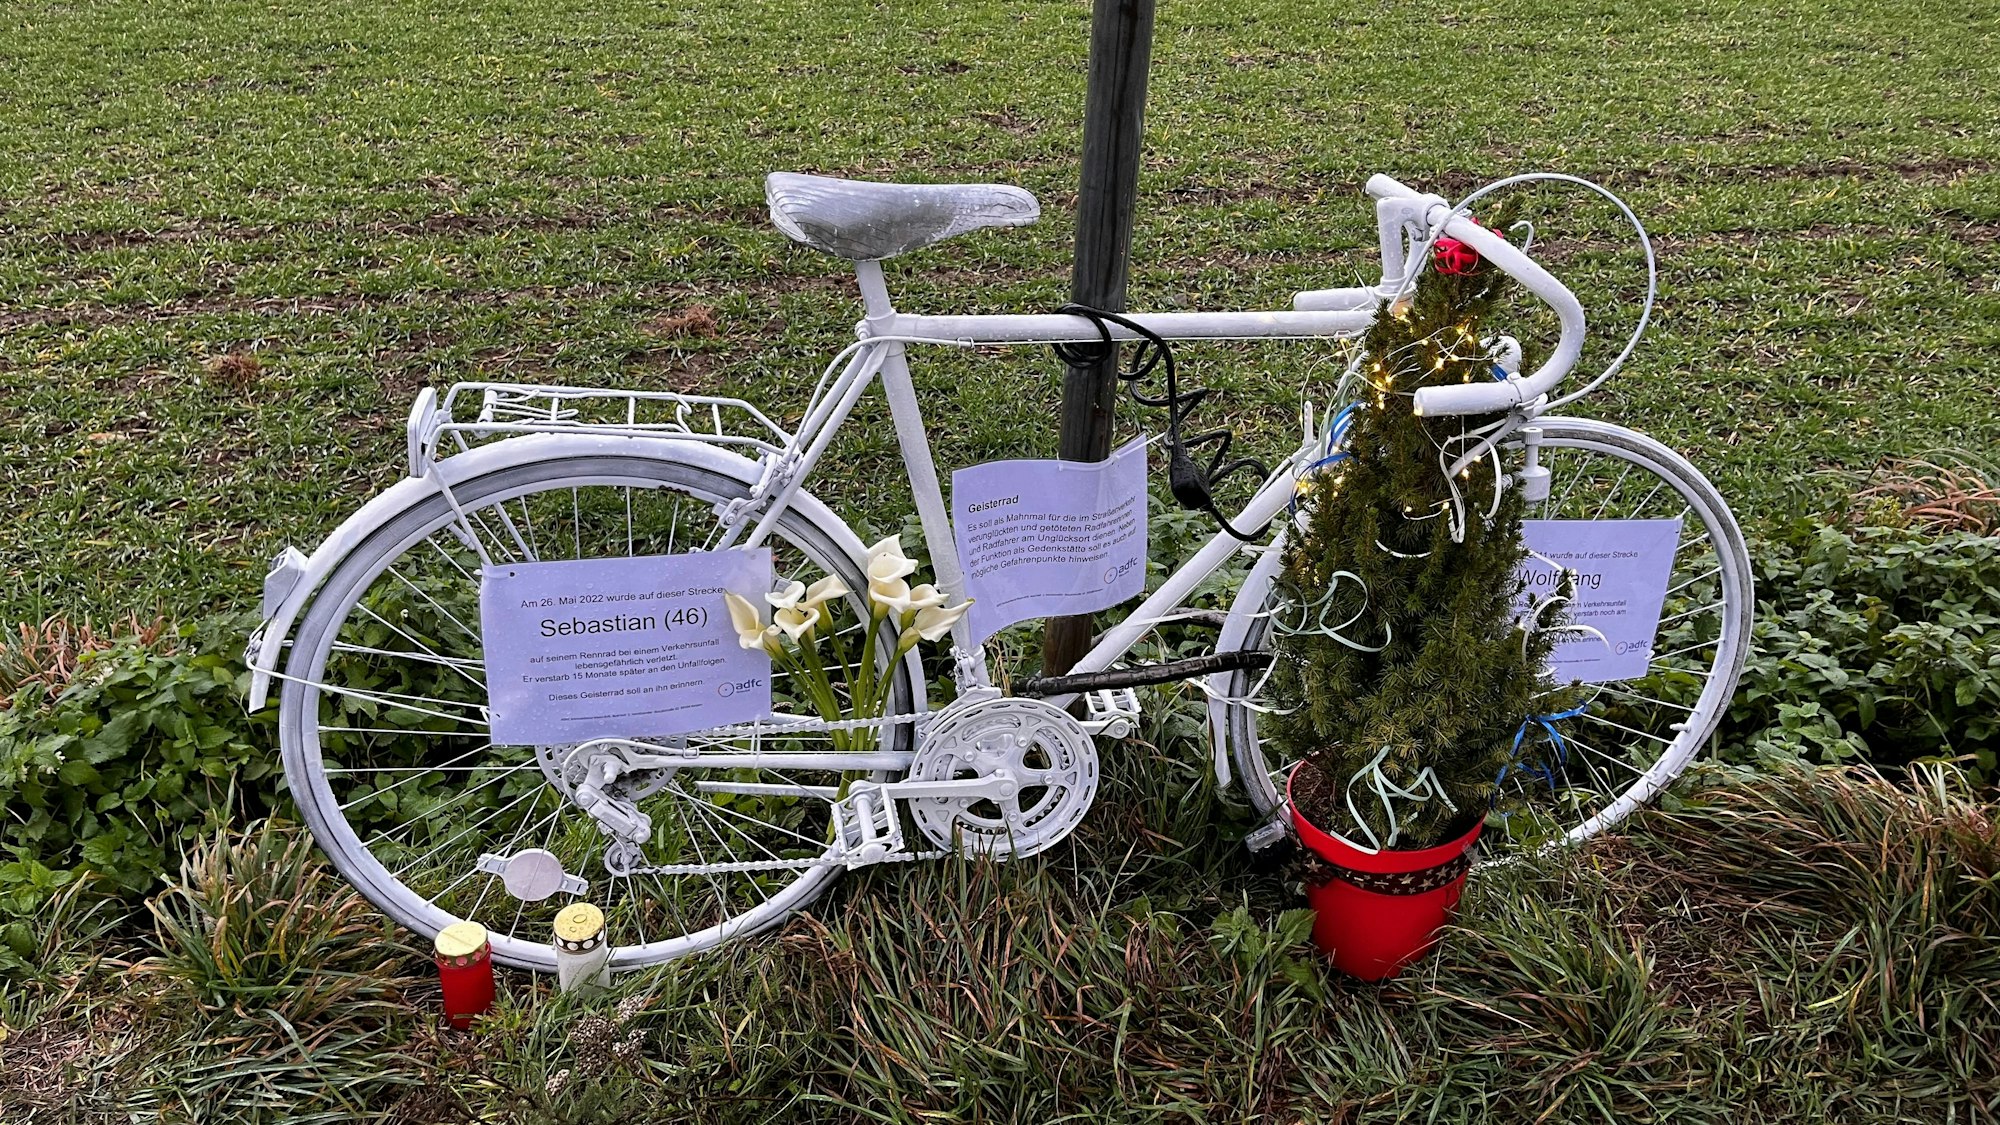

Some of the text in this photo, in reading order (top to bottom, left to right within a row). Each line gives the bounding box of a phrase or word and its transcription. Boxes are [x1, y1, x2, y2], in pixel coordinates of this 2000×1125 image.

[968, 494, 1019, 513] Geisterrad
[968, 524, 977, 532] Es
[979, 519, 992, 529] soll
[994, 517, 1004, 526] als
[1006, 513, 1046, 522] Mahnmal
[1048, 513, 1060, 521] für
[968, 525, 1018, 544] verunglückten
[1040, 524, 1082, 532] getöteten
[1084, 510, 1132, 532] Radfahrerinnen
[968, 546, 981, 556] und
[982, 536, 1020, 552] Radfahrer
[1038, 534, 1090, 543] Unglücksort
[1118, 518, 1136, 532] Neben
[970, 560, 980, 568] der
[981, 550, 1012, 564] Funktion
[1014, 546, 1025, 554] als
[1028, 544, 1086, 553] Gedenkstätte
[1088, 543, 1102, 552] soll
[1112, 534, 1126, 545] auch
[1127, 526, 1137, 538] auf
[971, 564, 998, 580] mögliche
[1000, 555, 1066, 569] Gefahrenpunkte
[1118, 557, 1138, 574] adfc
[1518, 569, 1602, 590] Wolfang
[520, 586, 724, 608] Am 26. Mai 2022 wurde auf dieser Strecke
[1584, 600, 1626, 608] Verkehrsunfall
[540, 606, 708, 637] Sebastian (46)
[530, 638, 720, 664] auf seinem Rennrad bei einem Verkehrsunfall
[1628, 640, 1648, 650] adfc
[574, 654, 678, 670] lebensgefährlich verletzt.
[522, 675, 532, 683] Er
[534, 674, 570, 682] verstarb
[573, 672, 584, 680] 15
[586, 670, 618, 679] Monate
[620, 667, 646, 677] später
[736, 679, 762, 690] adfc
[548, 693, 578, 702] Dieses
[580, 688, 624, 698] Geisterrad
[656, 684, 668, 692] ihn
